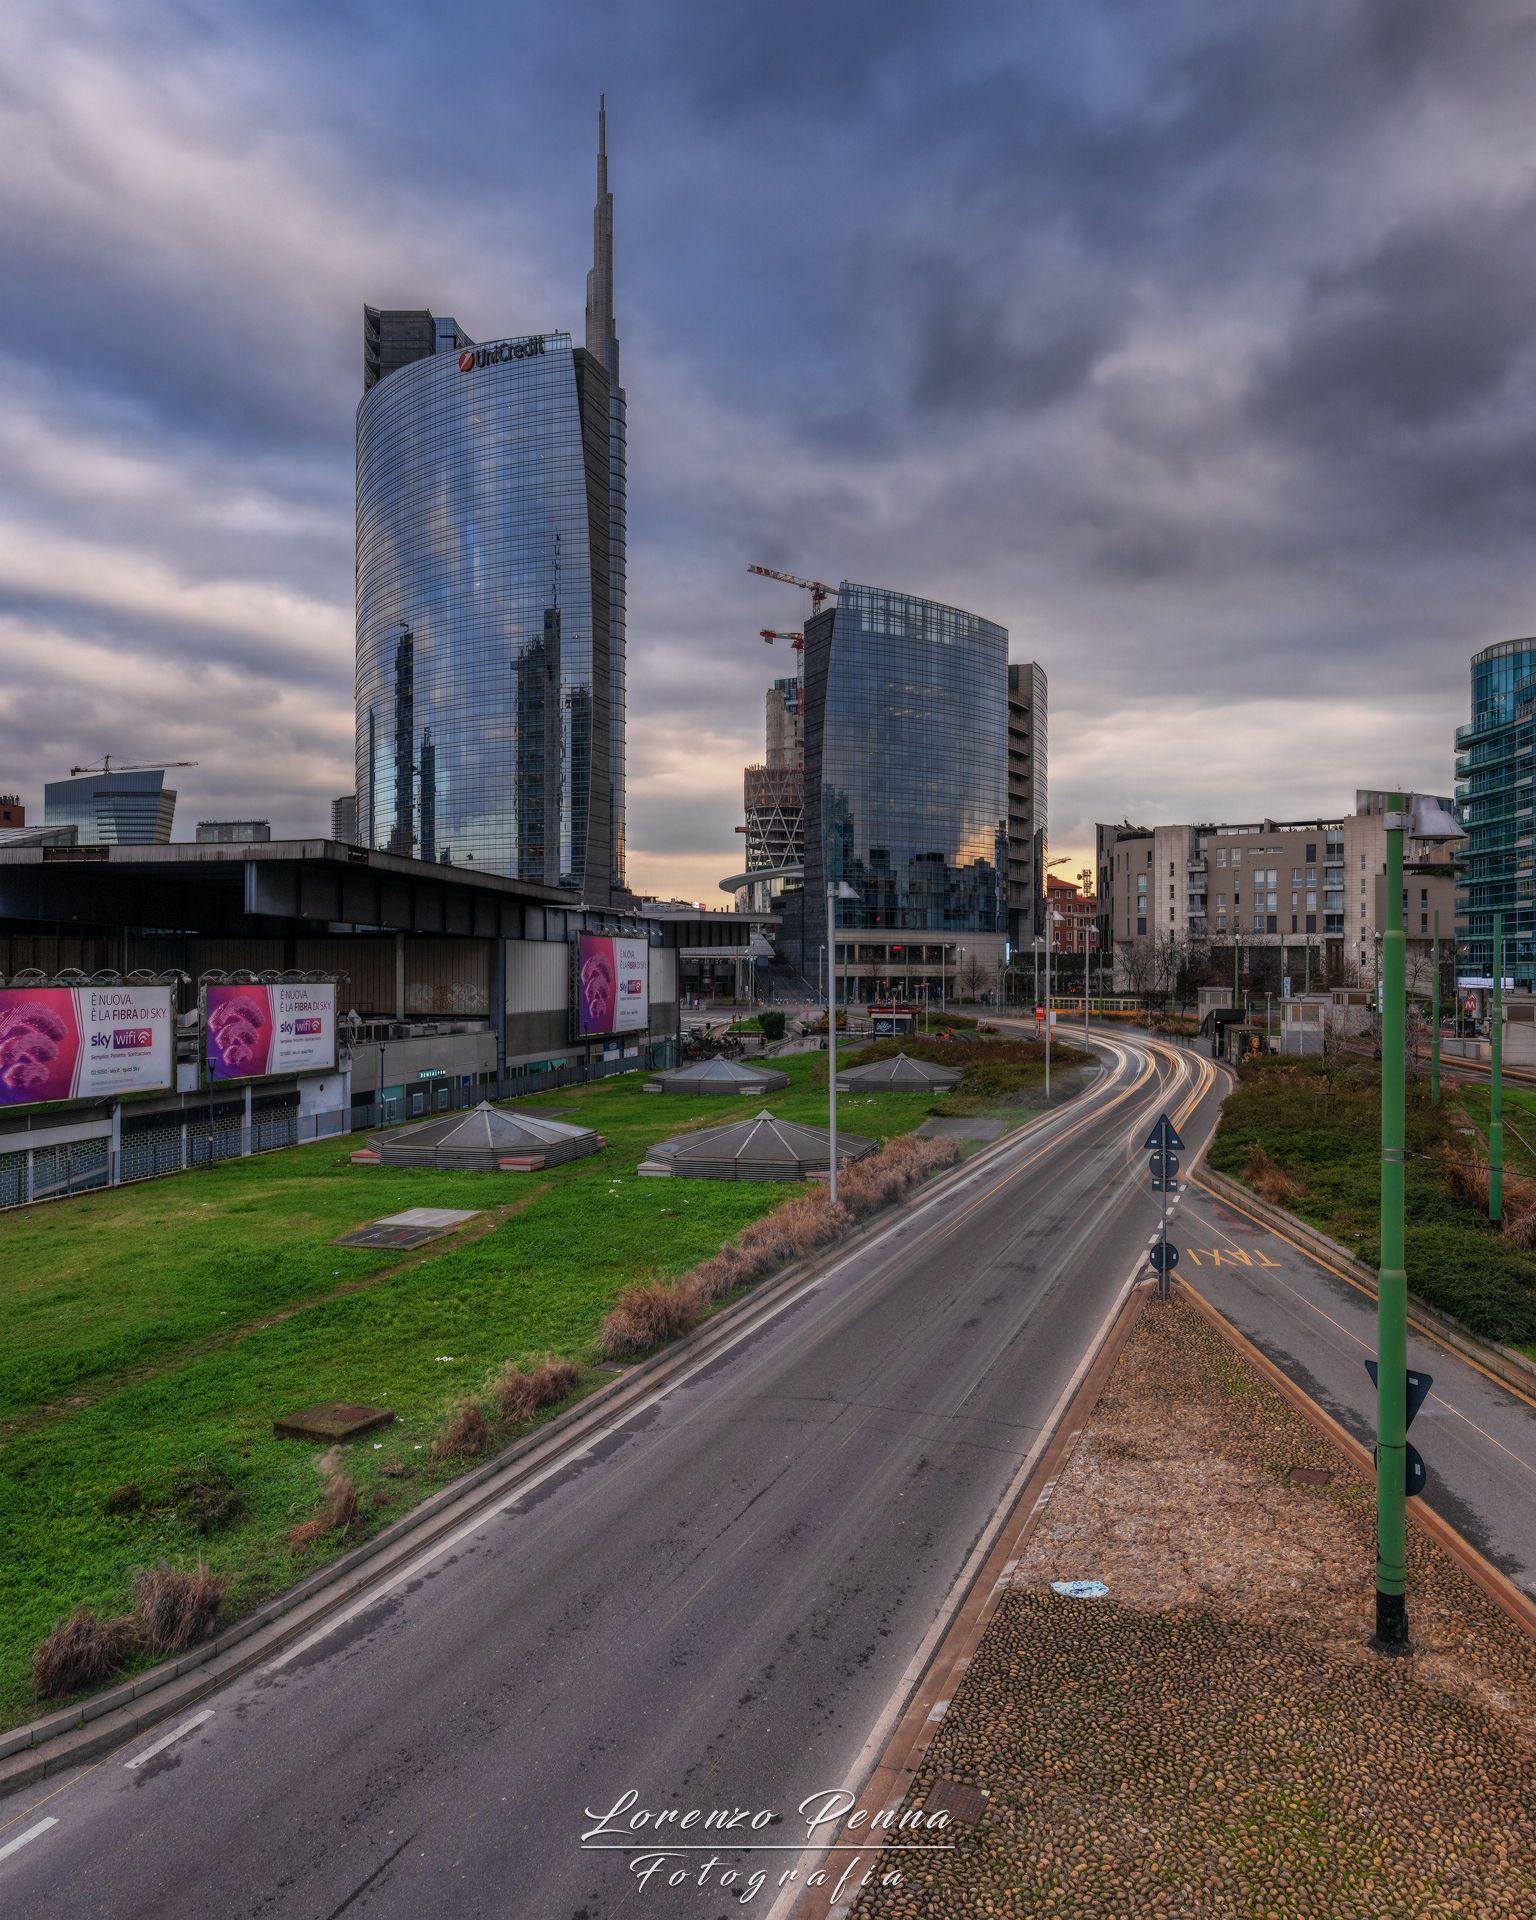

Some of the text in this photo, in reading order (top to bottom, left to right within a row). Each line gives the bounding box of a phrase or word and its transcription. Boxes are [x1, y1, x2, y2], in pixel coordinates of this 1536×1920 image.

[475, 335, 545, 368] UniCredit
[91, 992, 134, 1006] È NUOVA.
[280, 989, 308, 999] È NUOVA.
[280, 1001, 284, 1012] È
[285, 1003, 293, 1012] LA
[294, 1002, 312, 1011] FIBRA
[313, 1001, 319, 1011] DI
[91, 1007, 168, 1021] È LA FIBRA DI SKY.
[280, 1020, 311, 1034] sky wifi
[91, 1030, 136, 1049] sky wifi
[1186, 1248, 1282, 1267] TAXI
